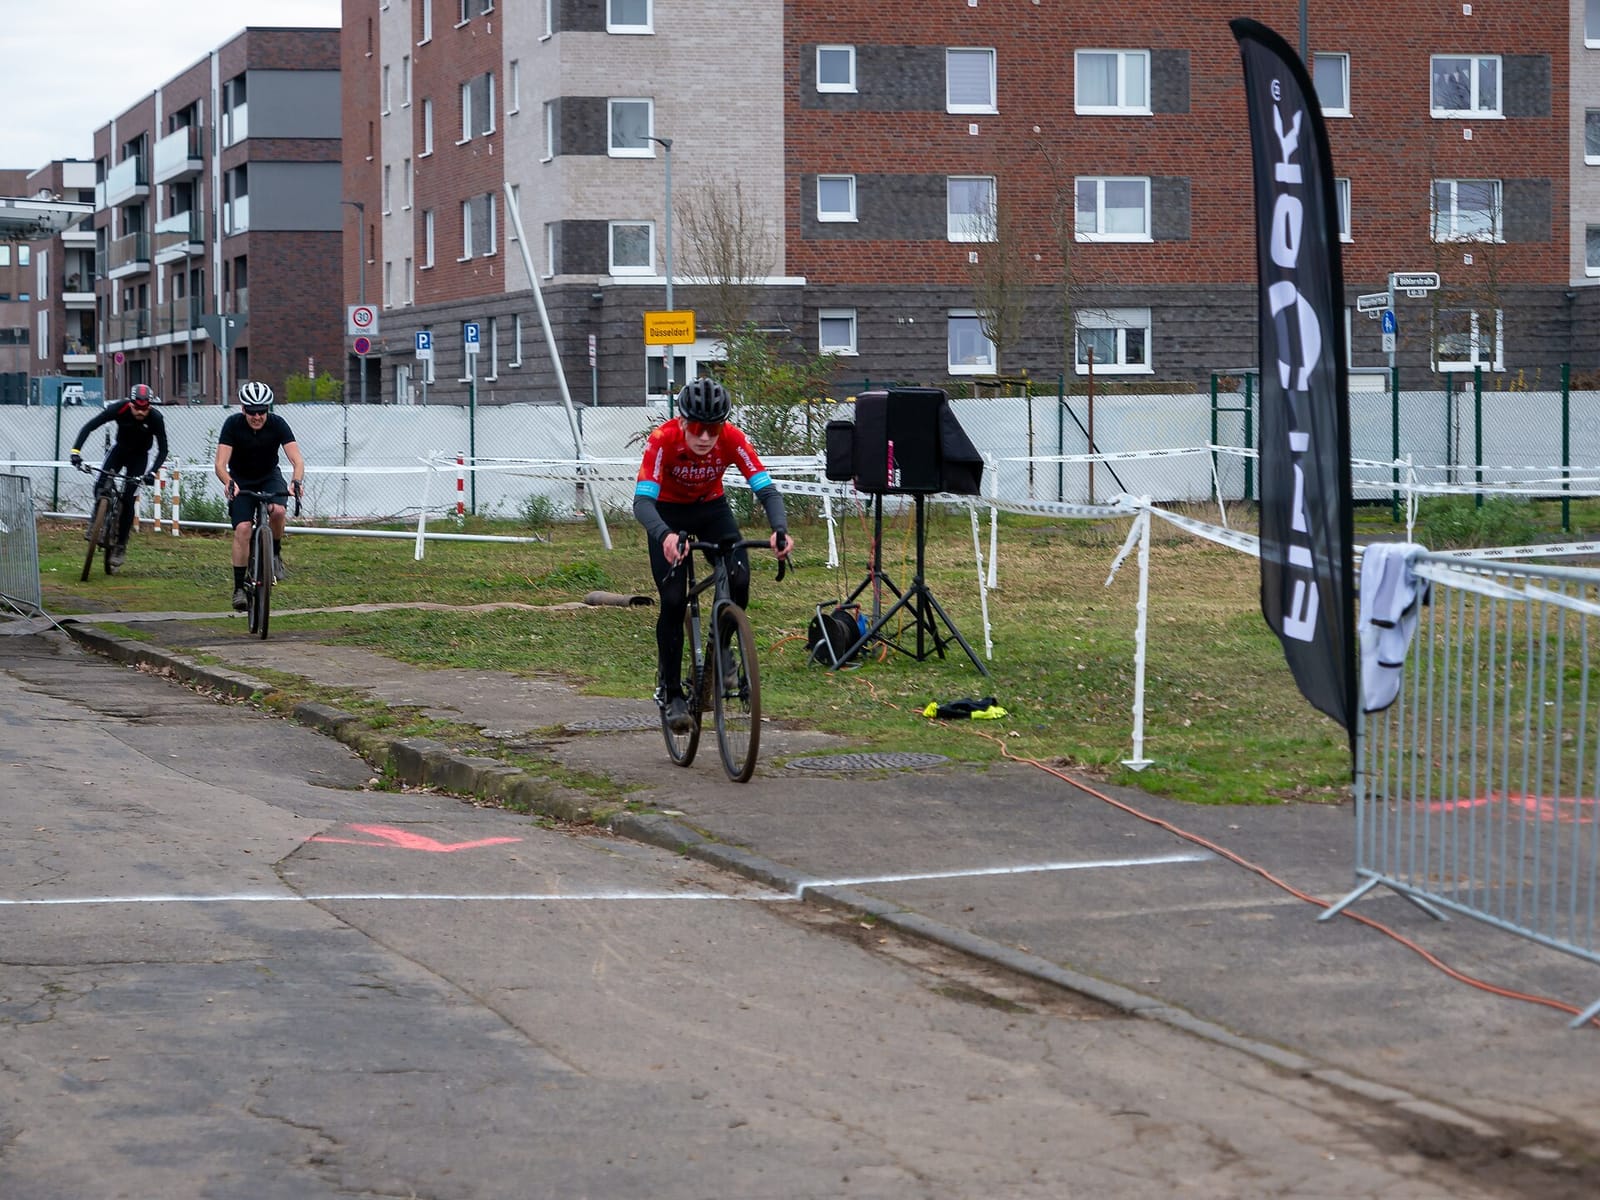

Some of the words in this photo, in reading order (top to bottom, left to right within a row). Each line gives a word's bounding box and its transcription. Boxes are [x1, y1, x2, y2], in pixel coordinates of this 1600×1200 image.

[356, 311, 369, 322] 30
[467, 326, 477, 342] P
[649, 327, 689, 337] Düsseldorf
[418, 333, 428, 349] P
